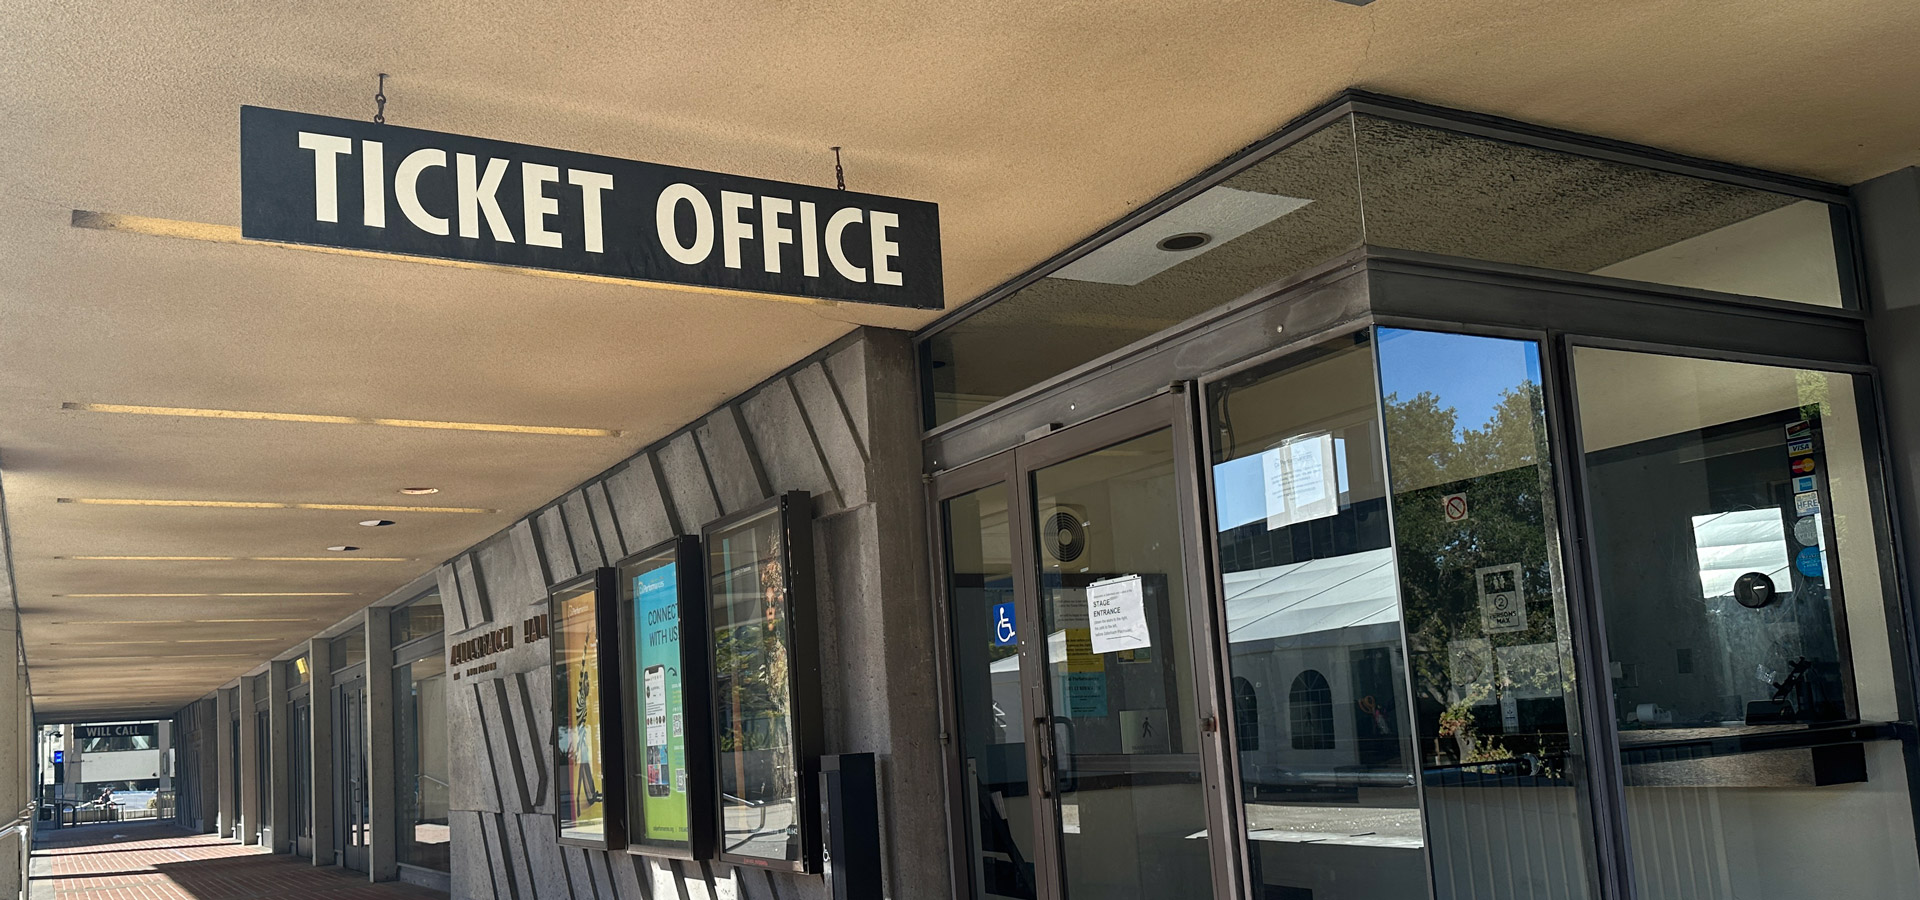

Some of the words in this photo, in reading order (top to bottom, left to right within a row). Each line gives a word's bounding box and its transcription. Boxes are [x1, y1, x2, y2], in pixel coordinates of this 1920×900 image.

[298, 131, 614, 254] TICKET
[655, 182, 904, 287] OFFICE
[1792, 443, 1810, 452] VISA
[1796, 499, 1819, 510] HERE
[1093, 599, 1111, 608] STAGE
[1093, 607, 1121, 617] ENTRANCE
[649, 629, 668, 647] WITH
[86, 727, 111, 737] WILL
[115, 725, 140, 736] CALL
